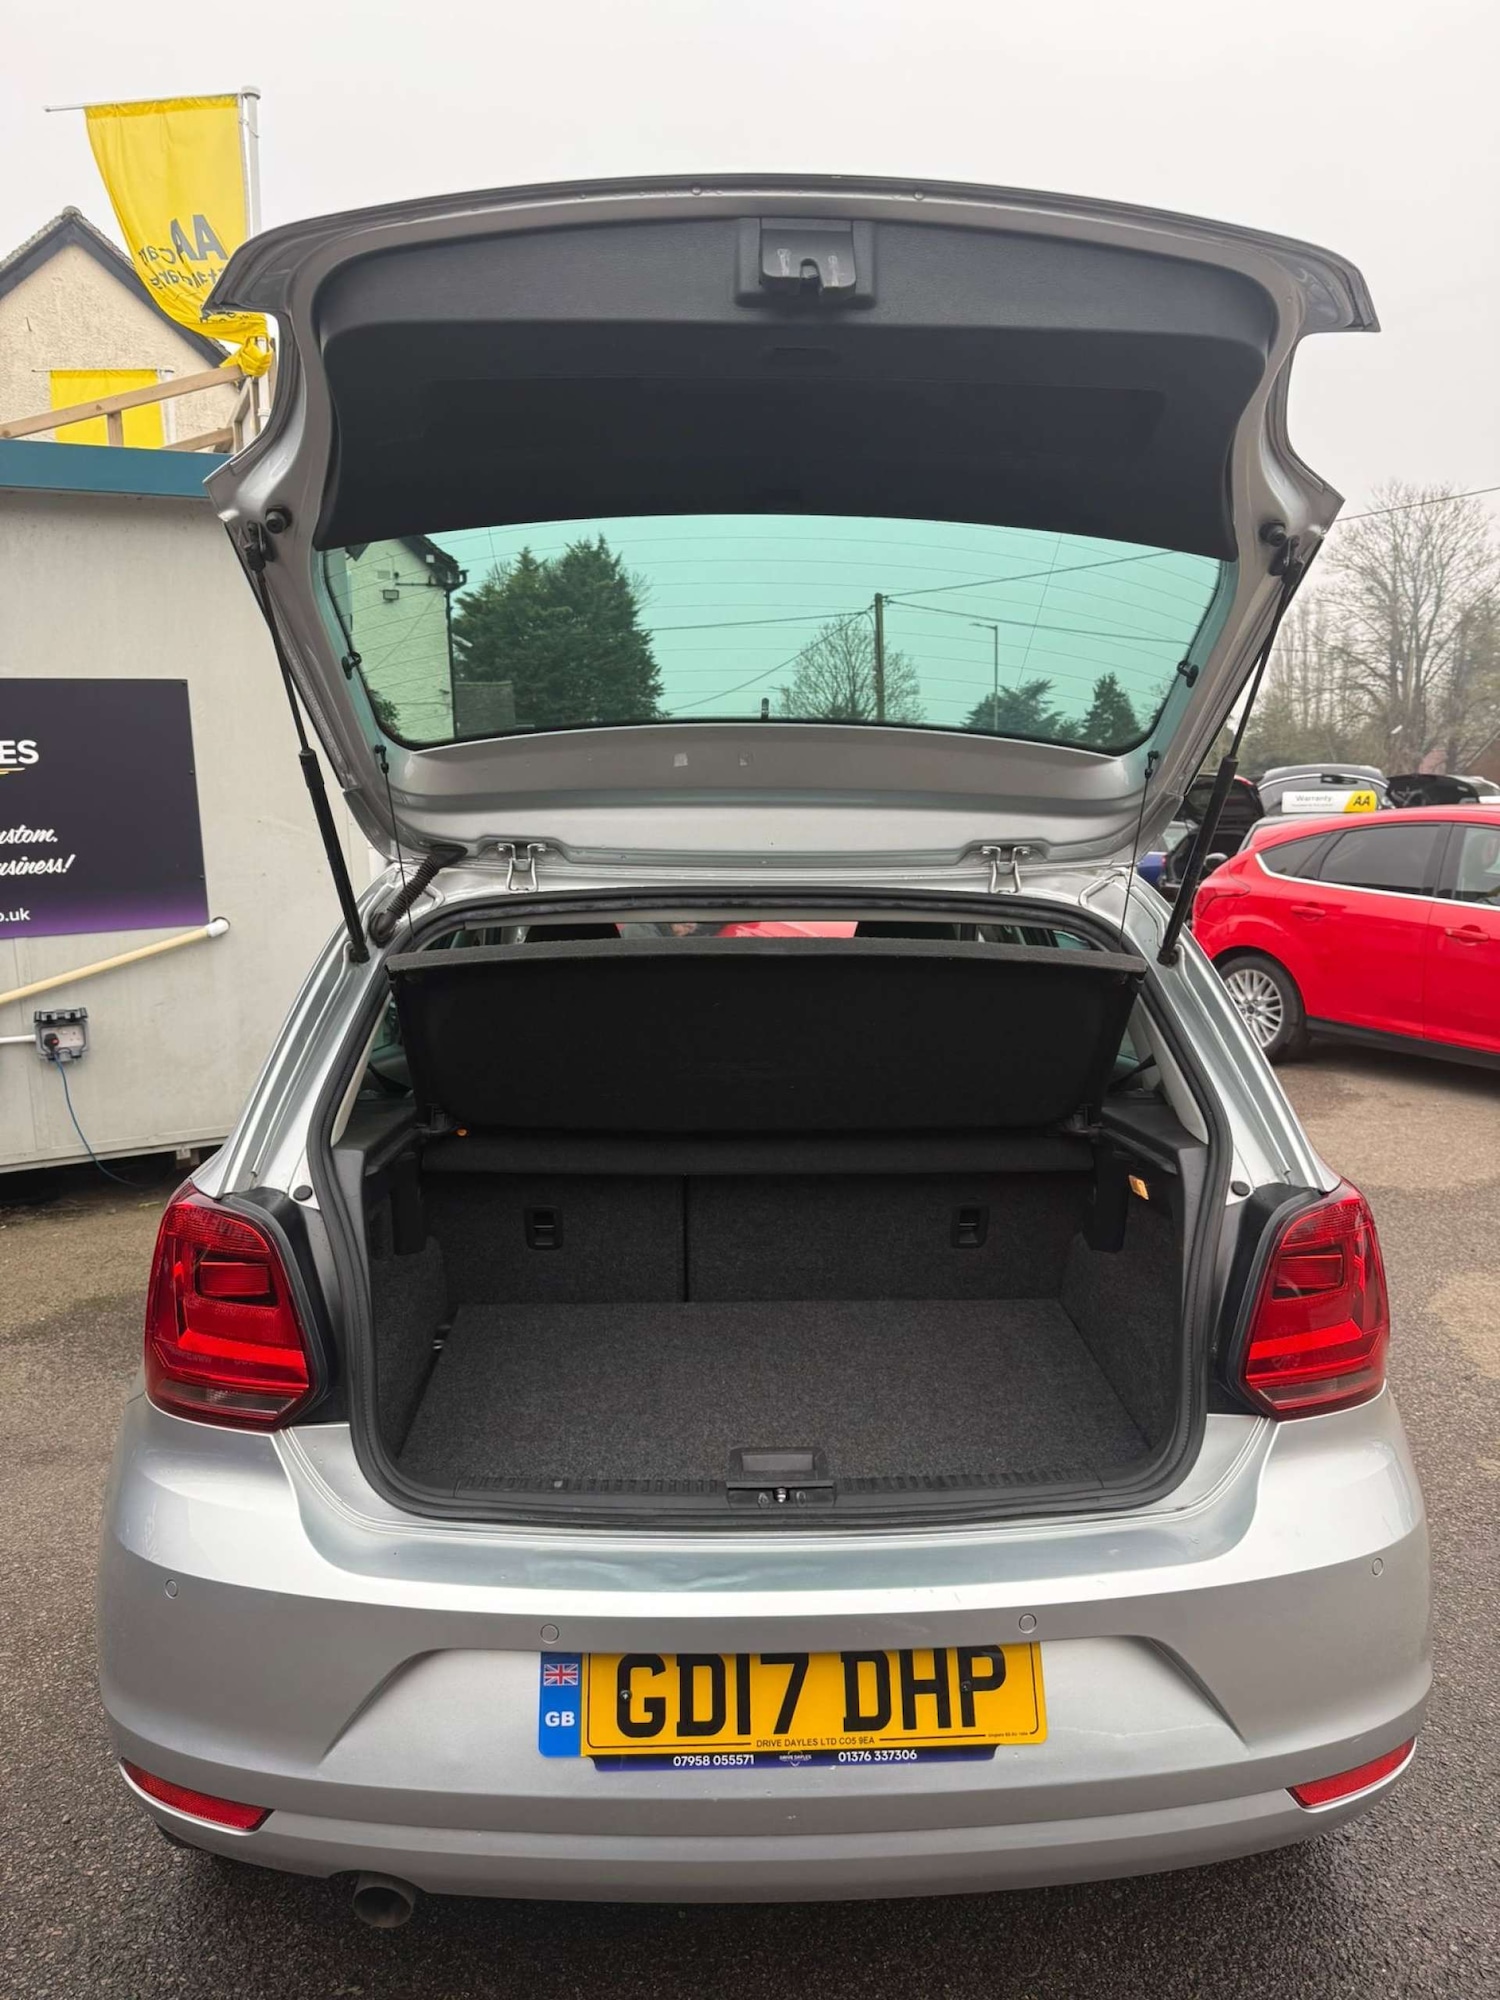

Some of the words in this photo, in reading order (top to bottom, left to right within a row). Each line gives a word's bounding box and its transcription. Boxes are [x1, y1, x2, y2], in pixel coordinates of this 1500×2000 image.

[1295, 795, 1332, 803] Warranty
[1353, 795, 1371, 806] AA
[840, 1645, 1007, 1733] DHP
[545, 1711, 575, 1727] GB
[756, 1739, 782, 1748] DRIVE
[784, 1738, 818, 1747] DAYLES
[820, 1738, 837, 1746] LTD
[673, 1755, 710, 1767] 07958
[713, 1754, 755, 1766] 055571
[838, 1751, 872, 1763] 01376
[874, 1750, 918, 1761] 337306
